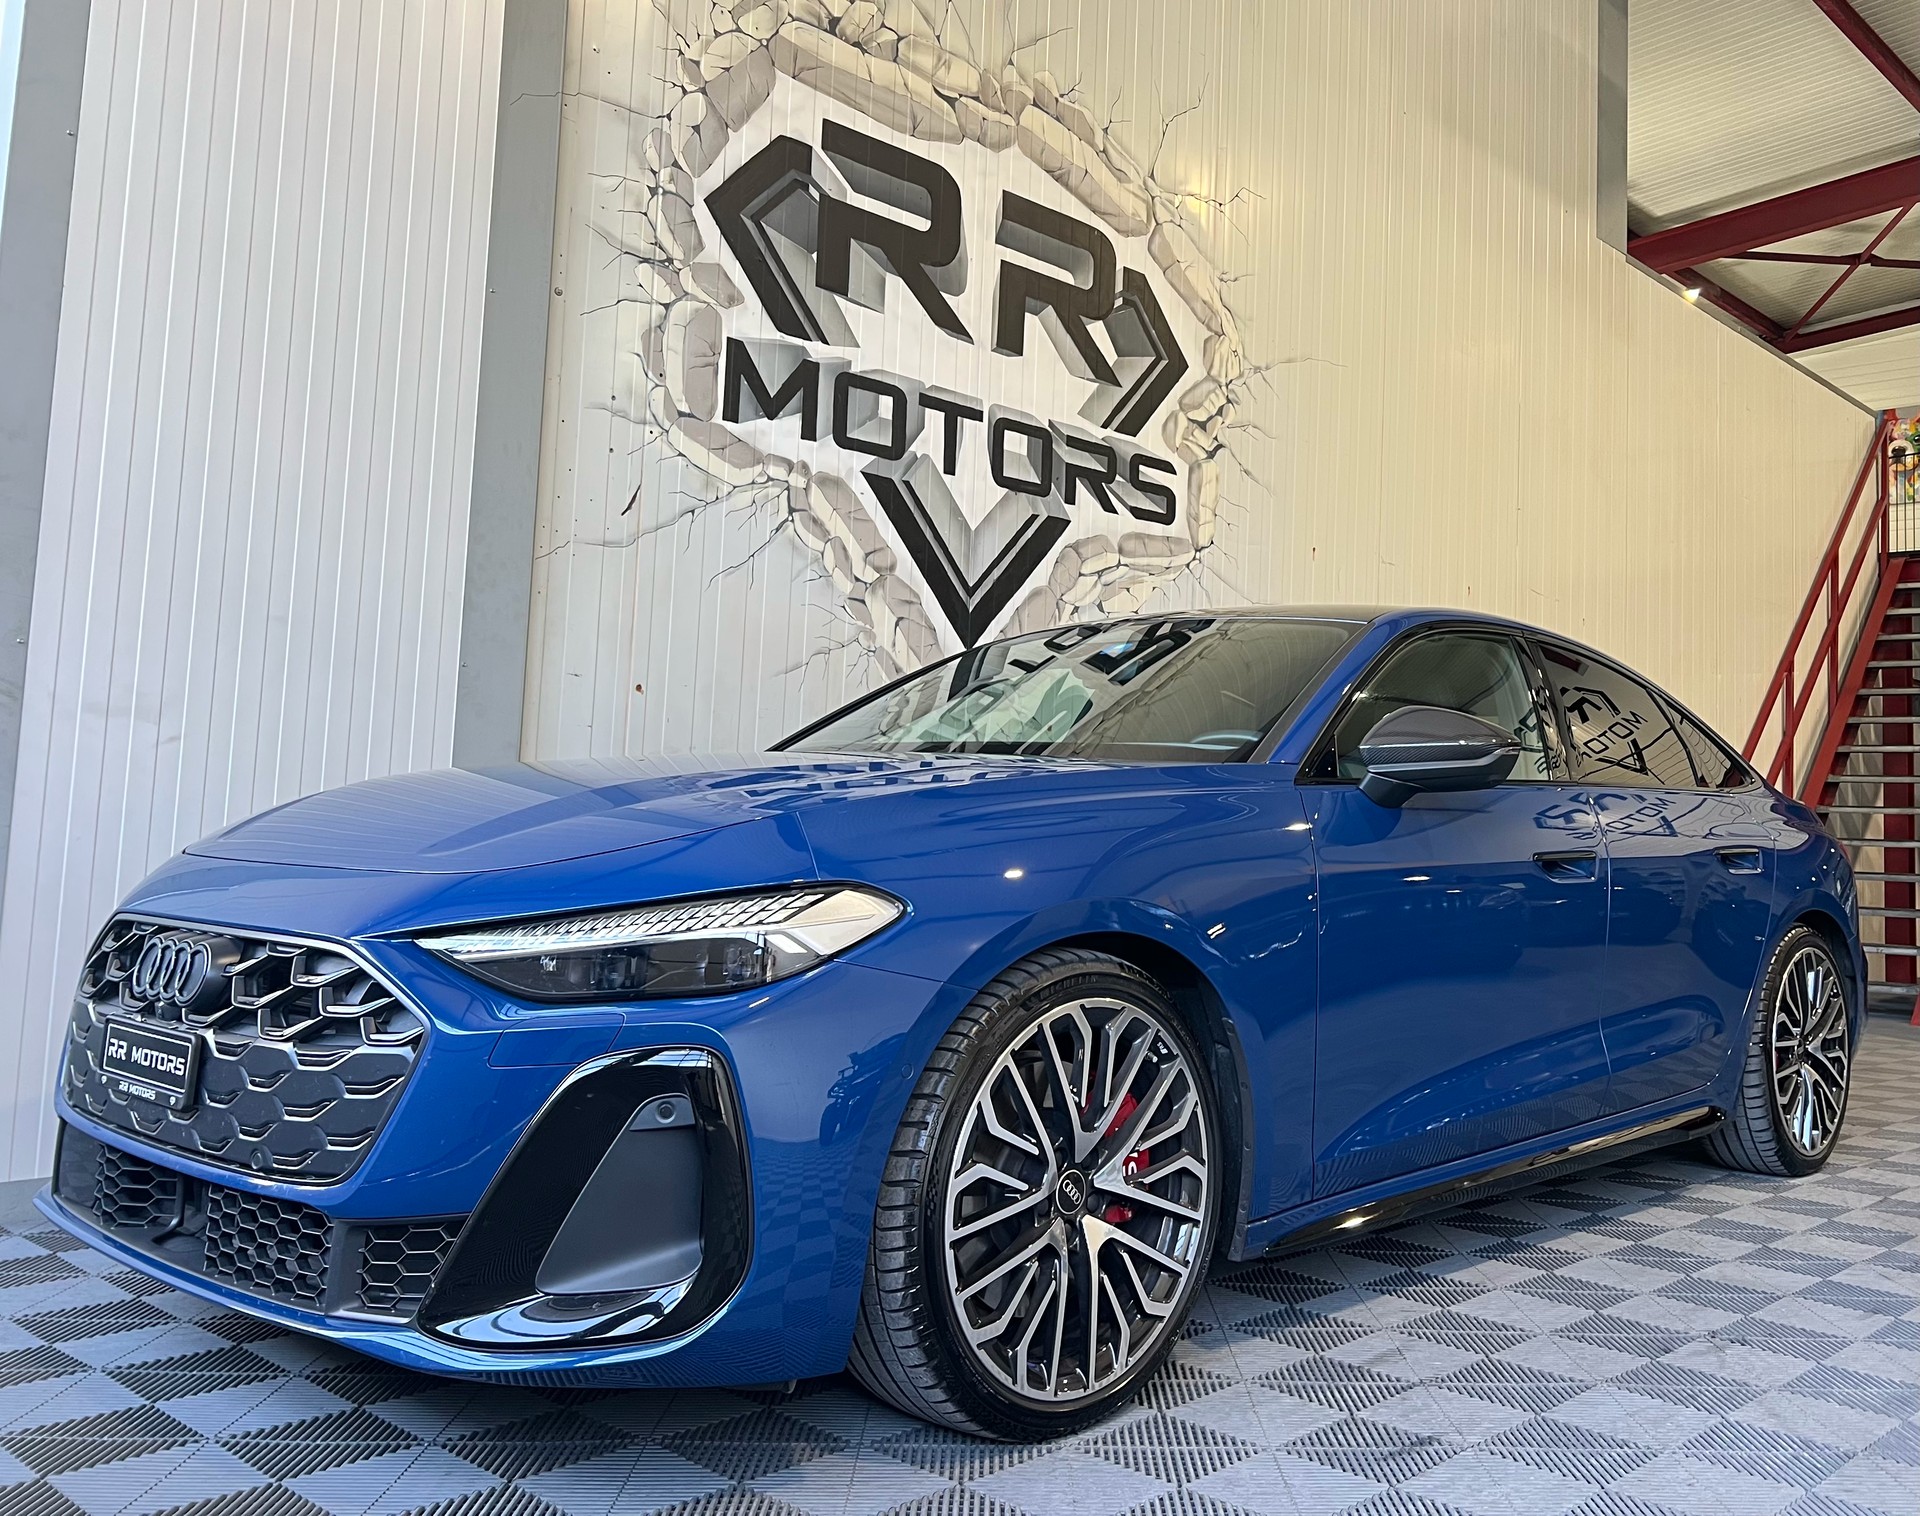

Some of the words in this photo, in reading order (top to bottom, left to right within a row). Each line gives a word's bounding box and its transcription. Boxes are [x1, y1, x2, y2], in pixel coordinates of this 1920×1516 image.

[815, 118, 1122, 387] RR
[722, 336, 1177, 526] MOTORS
[108, 1038, 127, 1060] RR
[131, 1046, 185, 1076] MOTORS
[119, 1081, 128, 1092] RR
[129, 1085, 155, 1100] MOTORS
